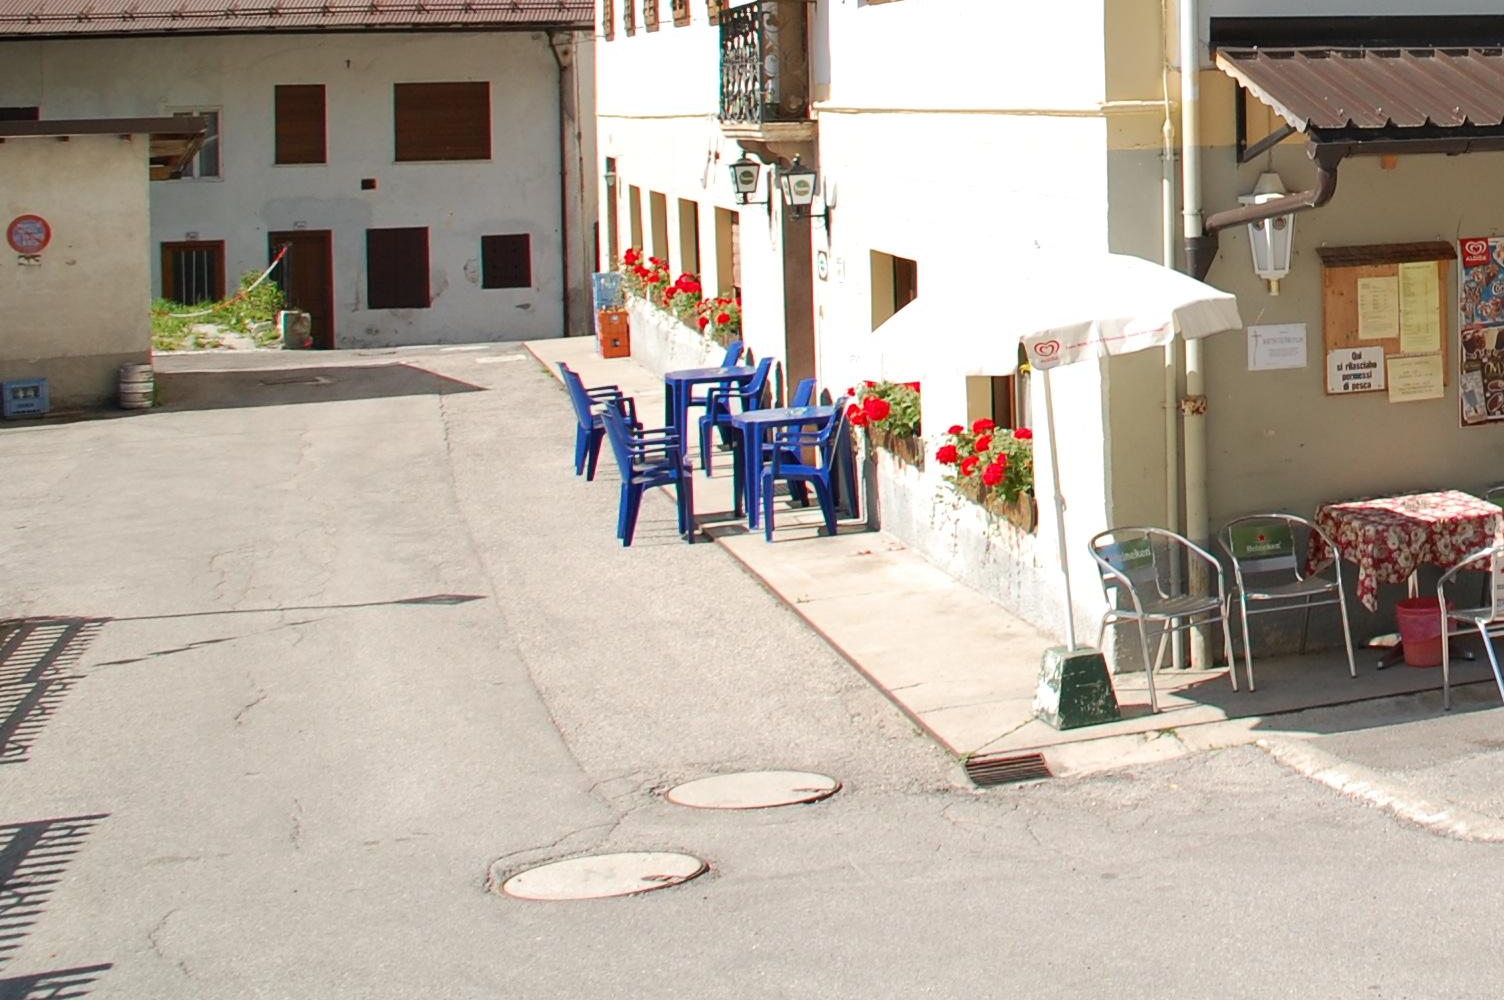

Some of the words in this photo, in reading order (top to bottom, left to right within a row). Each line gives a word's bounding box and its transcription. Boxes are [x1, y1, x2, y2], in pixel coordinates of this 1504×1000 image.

[1352, 351, 1362, 361] Qui
[1345, 361, 1377, 371] rilasciano
[1352, 382, 1371, 391] pesca
